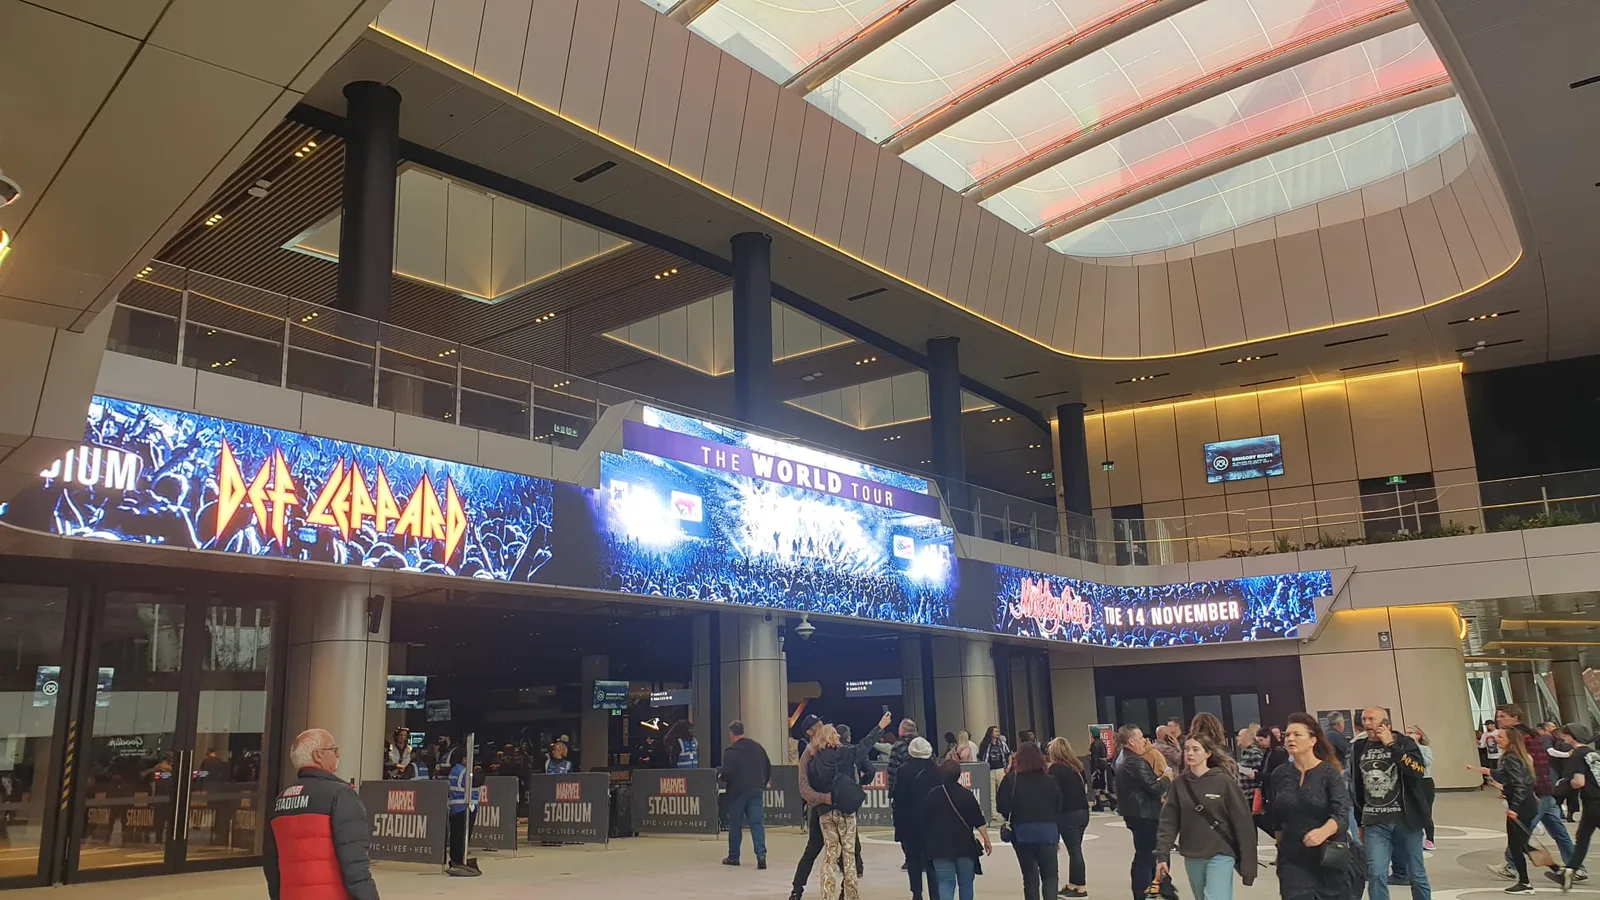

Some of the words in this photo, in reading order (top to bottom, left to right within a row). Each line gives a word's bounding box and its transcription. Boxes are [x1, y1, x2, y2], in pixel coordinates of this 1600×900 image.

[701, 446, 740, 472] THE
[751, 453, 842, 494] WORLD
[851, 482, 893, 507] TOUR
[214, 434, 300, 549] DEF
[305, 457, 468, 567] LEPPARD
[1104, 606, 1123, 626] TUE
[1127, 608, 1145, 626] 14
[1151, 601, 1240, 626] NOVEMBER
[555, 783, 580, 800] MARVEL
[660, 778, 687, 794] MARVEL
[275, 795, 310, 812] STADIUM
[387, 790, 416, 811] MARVEL
[648, 797, 700, 816] STADIUM
[543, 802, 592, 823] STADIUM
[372, 813, 428, 839] STADIUM
[581, 828, 597, 836] HERE
[387, 844, 407, 853] LIVES
[414, 846, 433, 855] HERE
